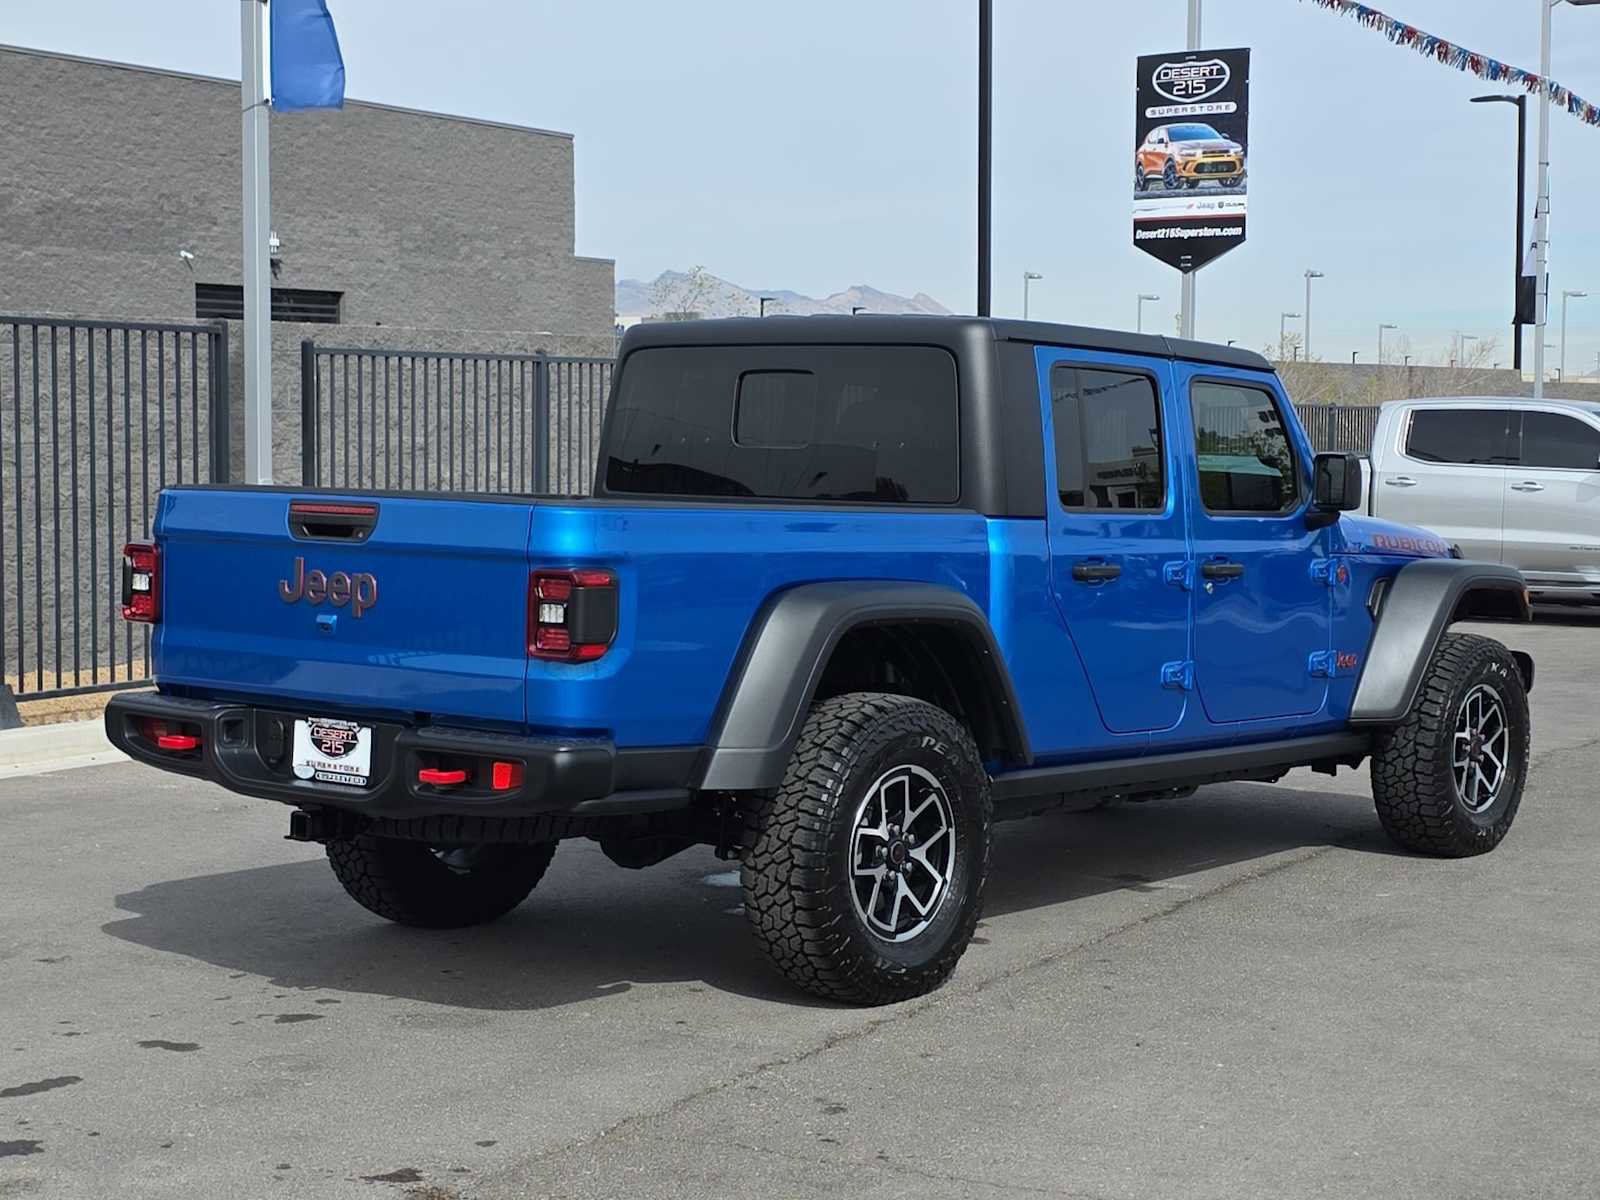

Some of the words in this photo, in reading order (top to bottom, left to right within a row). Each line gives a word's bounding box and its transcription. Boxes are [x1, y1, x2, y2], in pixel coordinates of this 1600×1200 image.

[1160, 66, 1221, 80] DESERT
[1172, 80, 1206, 95] 215
[1149, 104, 1232, 116] SUPERSTORE
[1373, 534, 1447, 554] RUBICON
[279, 556, 378, 618] Jeep
[313, 727, 354, 740] DESERT
[321, 740, 345, 754] 215
